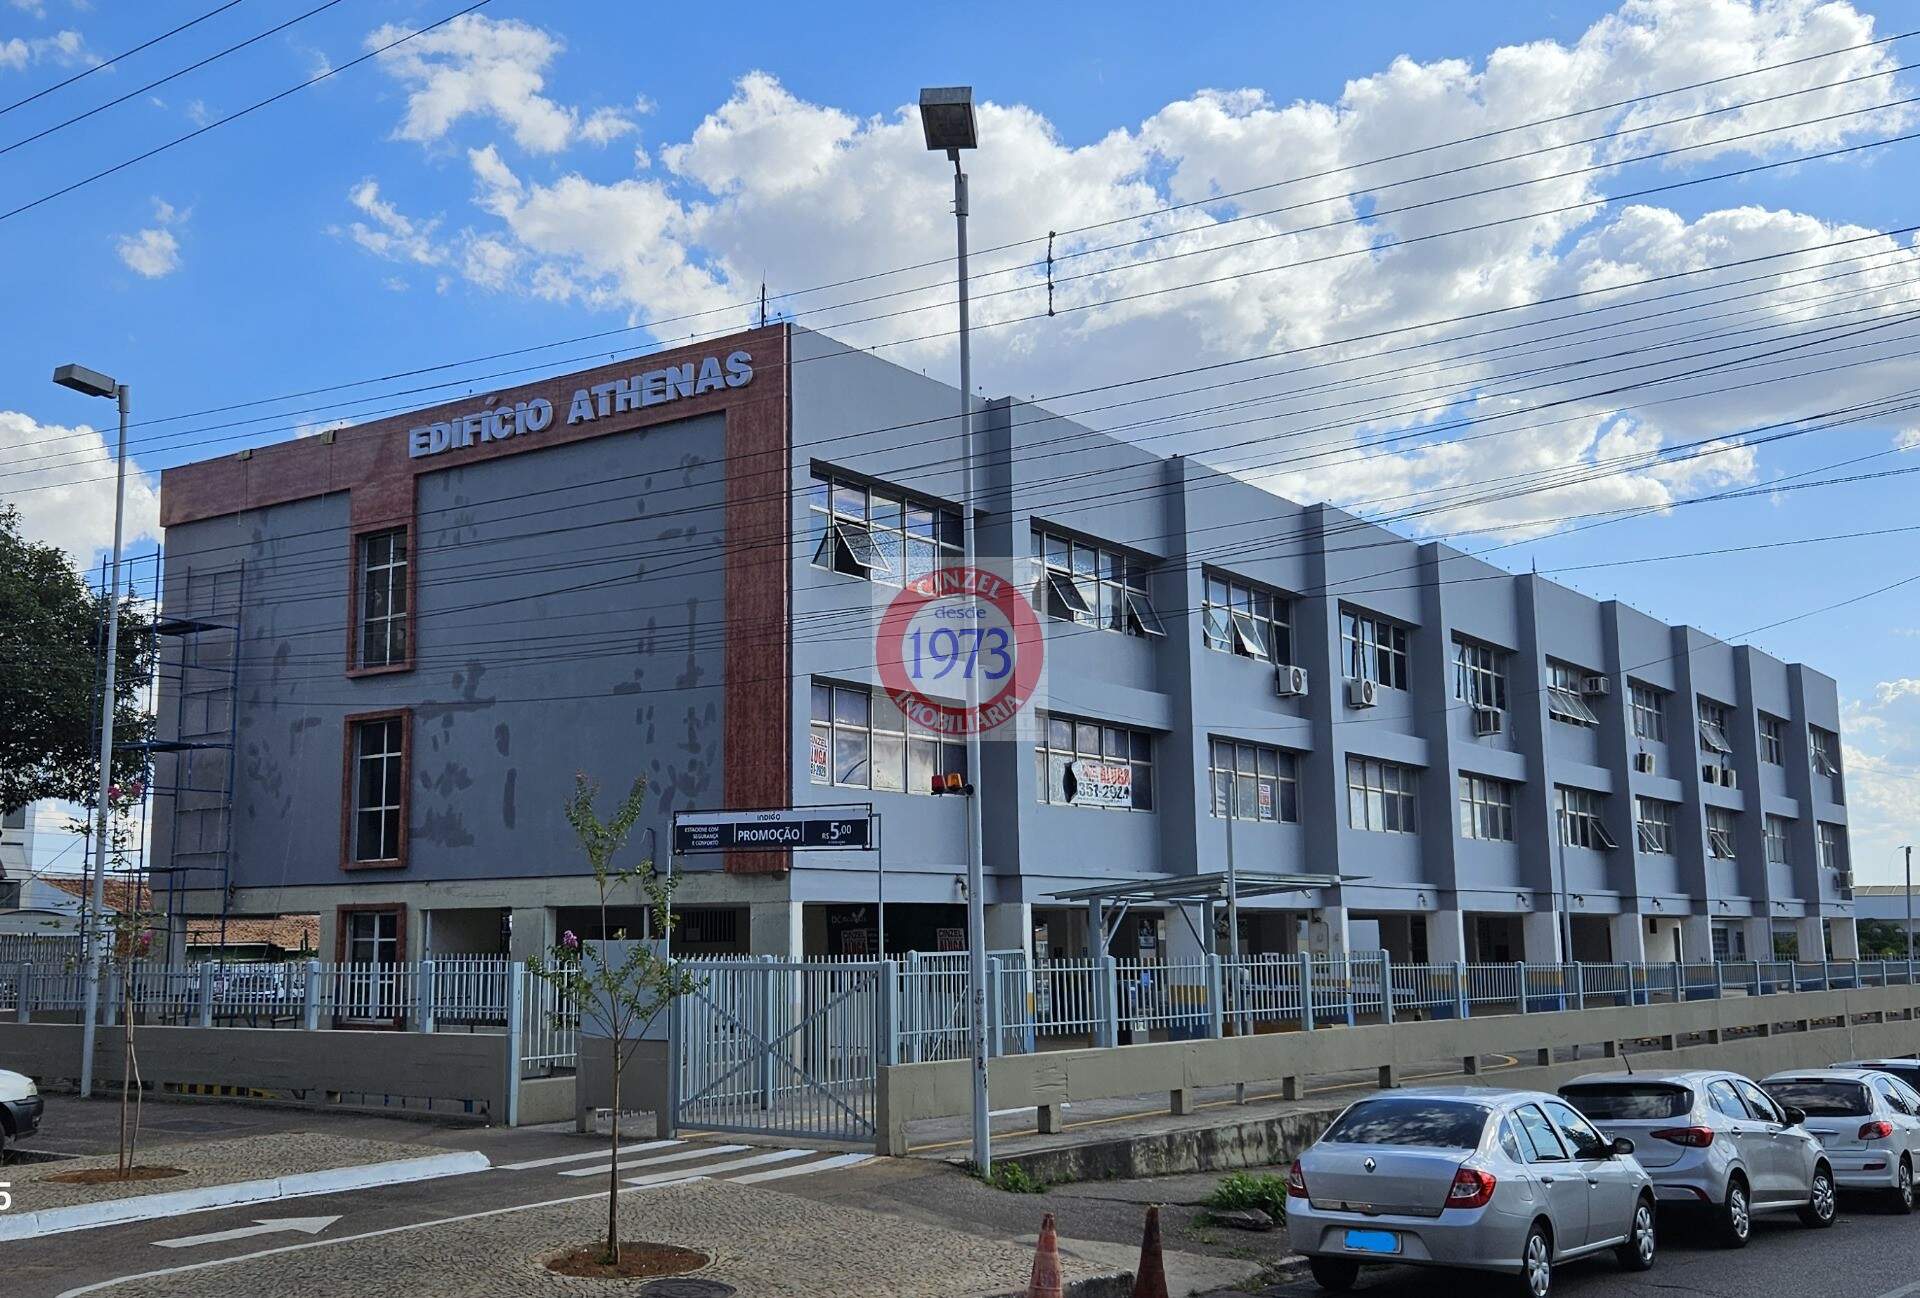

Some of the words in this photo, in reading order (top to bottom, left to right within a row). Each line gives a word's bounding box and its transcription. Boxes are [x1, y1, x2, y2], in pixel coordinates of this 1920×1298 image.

[408, 396, 553, 459] EDIFÍCIO
[566, 350, 754, 425] ATHENAS
[738, 826, 800, 843] PROMOÇÃO
[830, 822, 852, 840] 5,00
